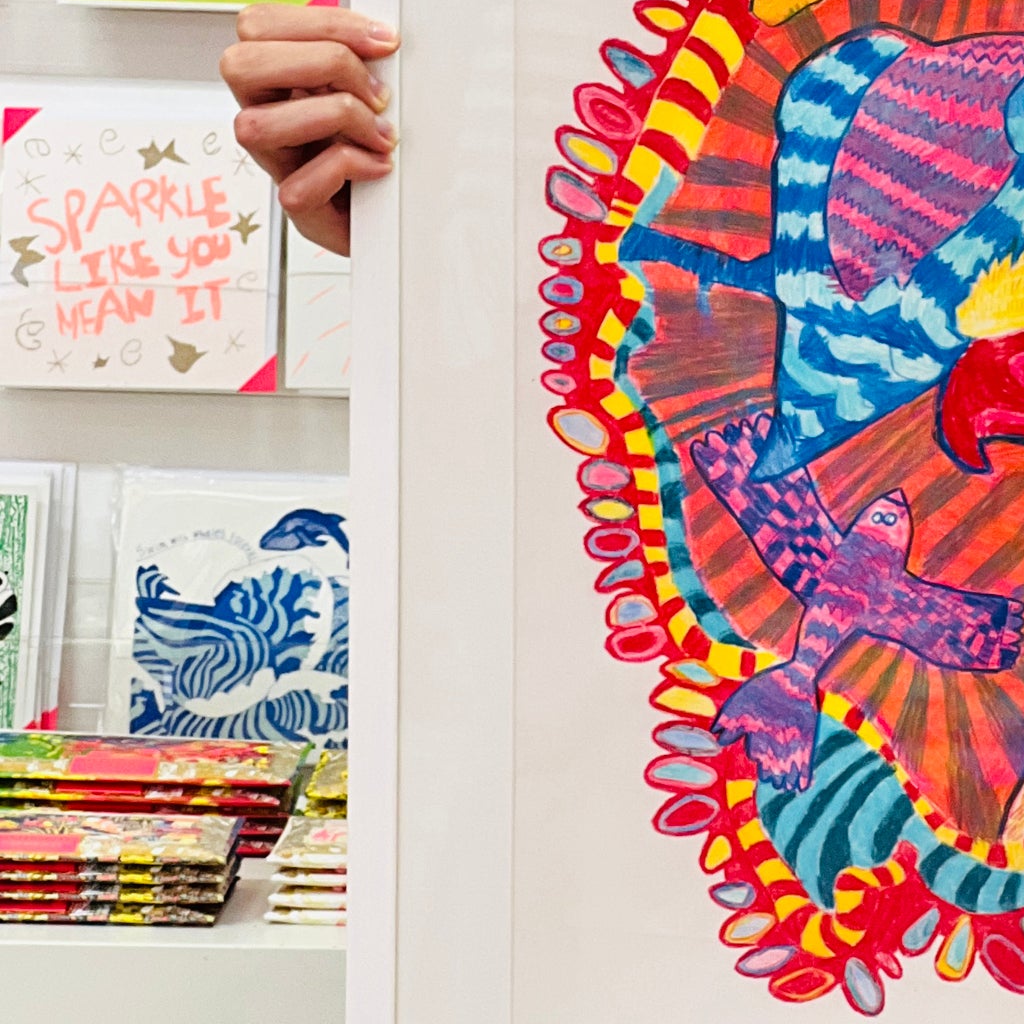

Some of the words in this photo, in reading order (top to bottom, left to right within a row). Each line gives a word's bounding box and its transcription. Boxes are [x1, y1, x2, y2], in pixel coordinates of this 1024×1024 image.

[27, 175, 231, 255] SPARKLE
[54, 240, 160, 292] LIKE
[167, 233, 231, 279] YOU
[56, 287, 155, 340] MEAN
[177, 278, 230, 324] IT
